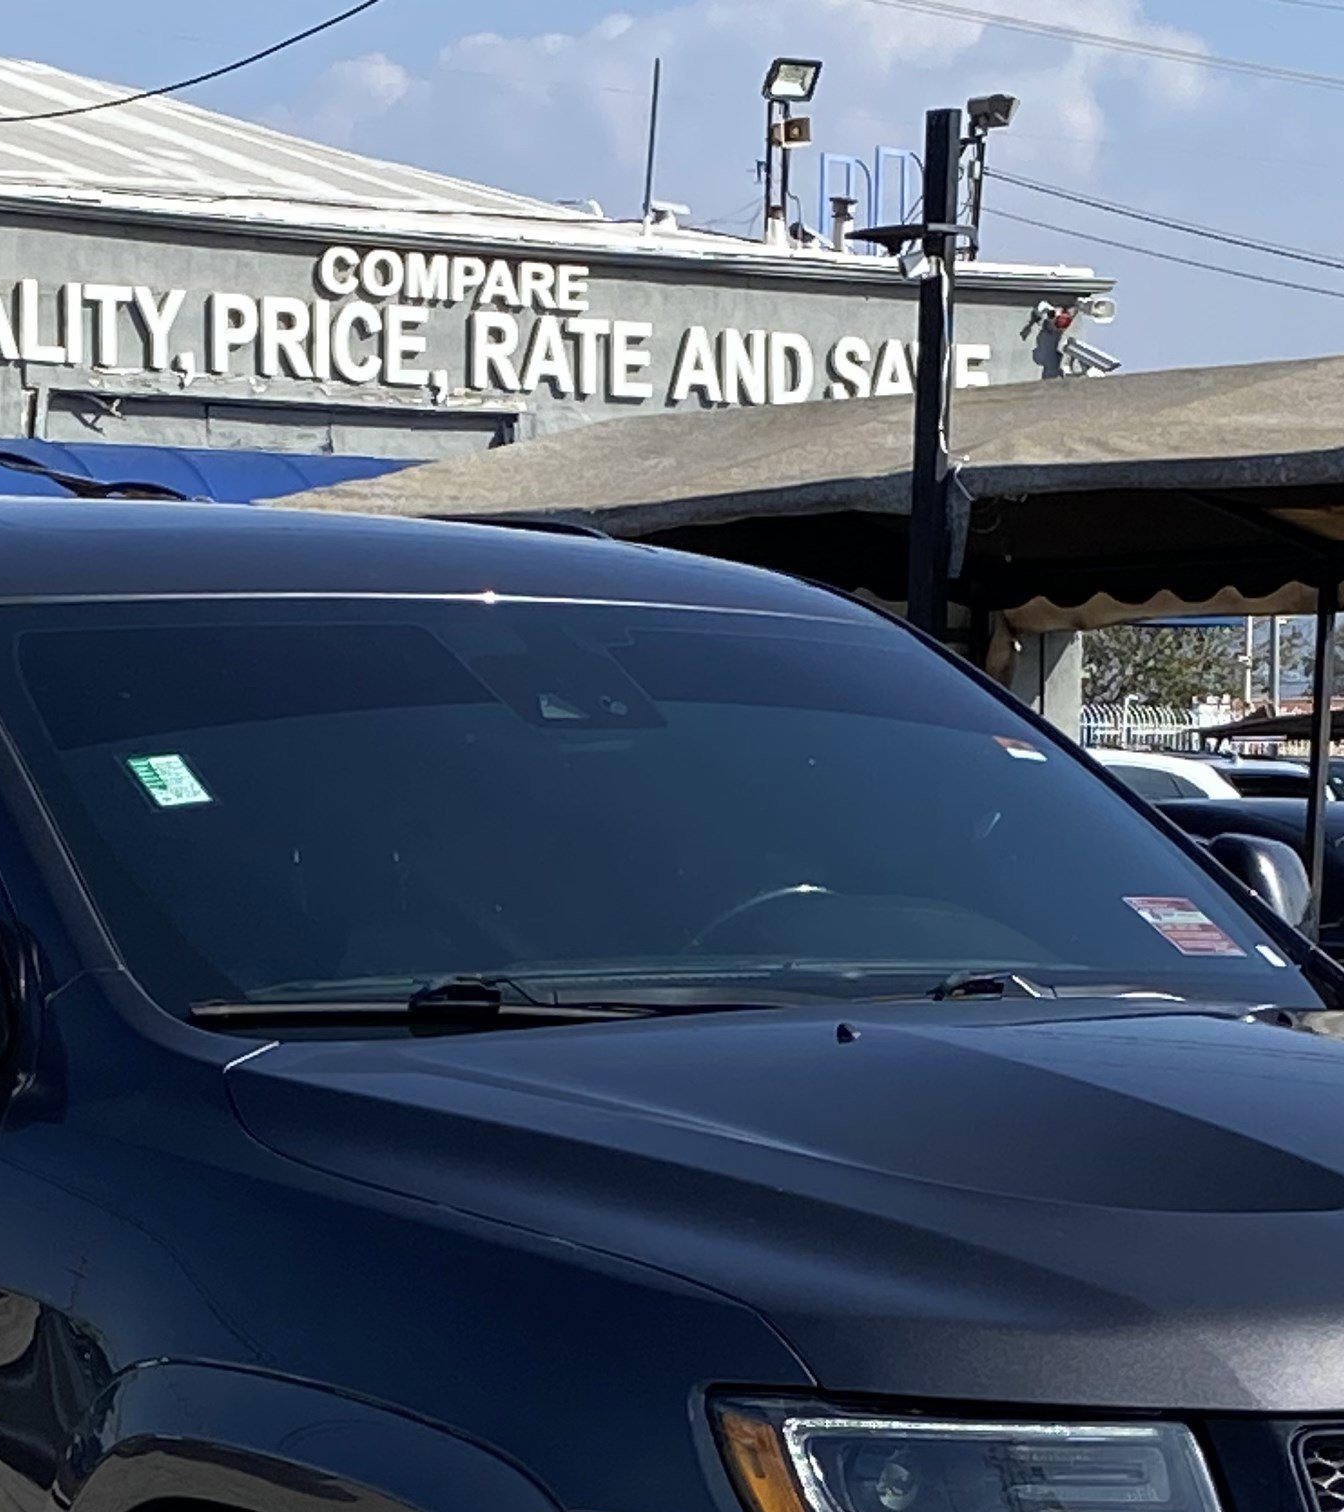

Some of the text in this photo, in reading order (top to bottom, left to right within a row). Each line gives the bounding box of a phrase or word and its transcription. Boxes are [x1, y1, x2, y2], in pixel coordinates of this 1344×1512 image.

[319, 246, 590, 312] COMPARE
[211, 293, 449, 403] PRICE,
[470, 310, 653, 399] RATE
[672, 325, 816, 406] AND
[830, 336, 992, 400] SAE
